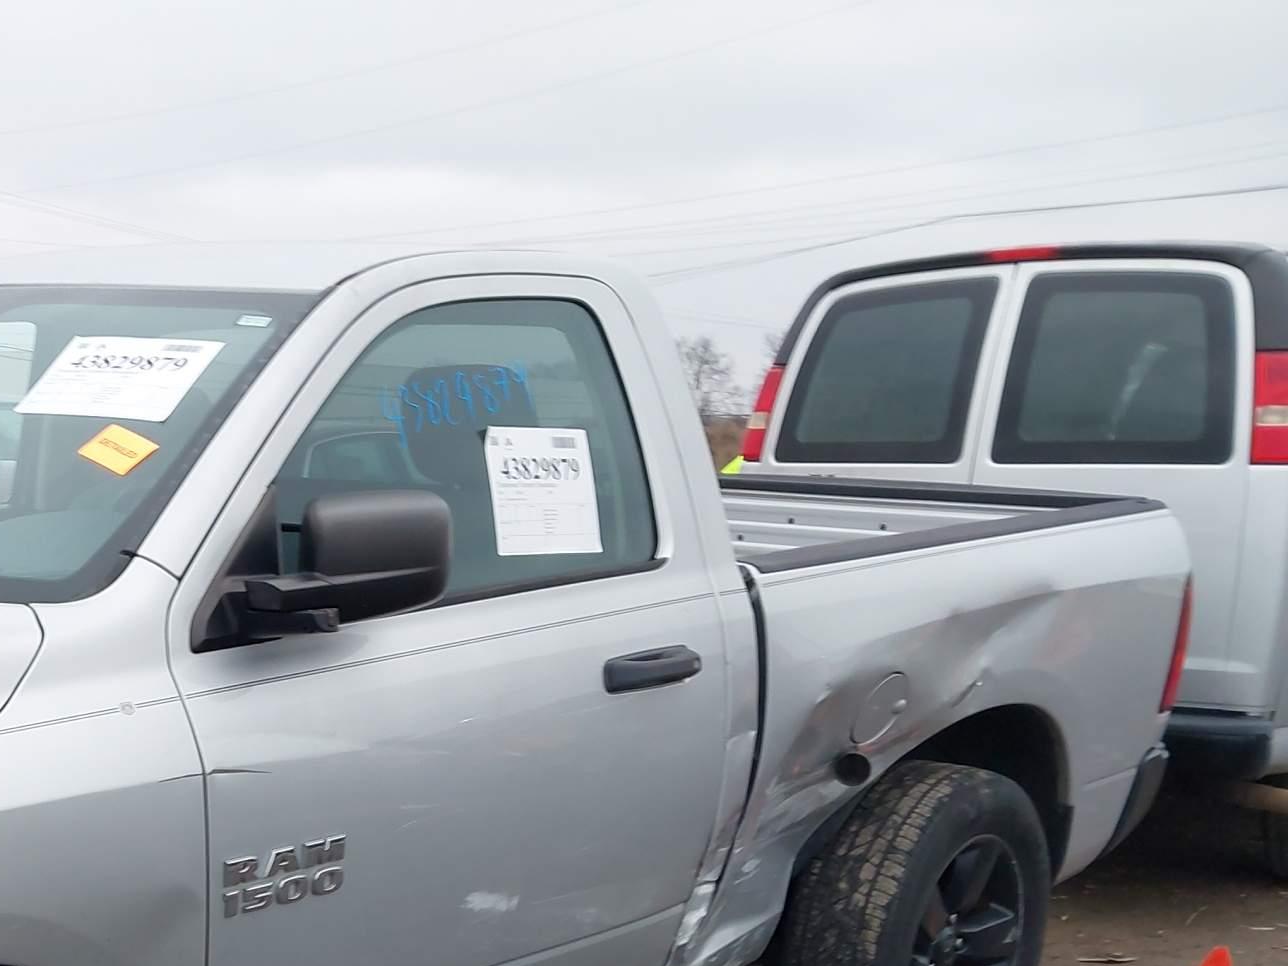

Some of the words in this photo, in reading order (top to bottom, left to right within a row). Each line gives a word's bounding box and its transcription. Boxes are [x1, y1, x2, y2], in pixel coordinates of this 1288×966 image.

[71, 355, 189, 372] 43829879
[501, 457, 581, 481] 43829879
[223, 833, 347, 888] RAM
[222, 865, 345, 918] 1500
